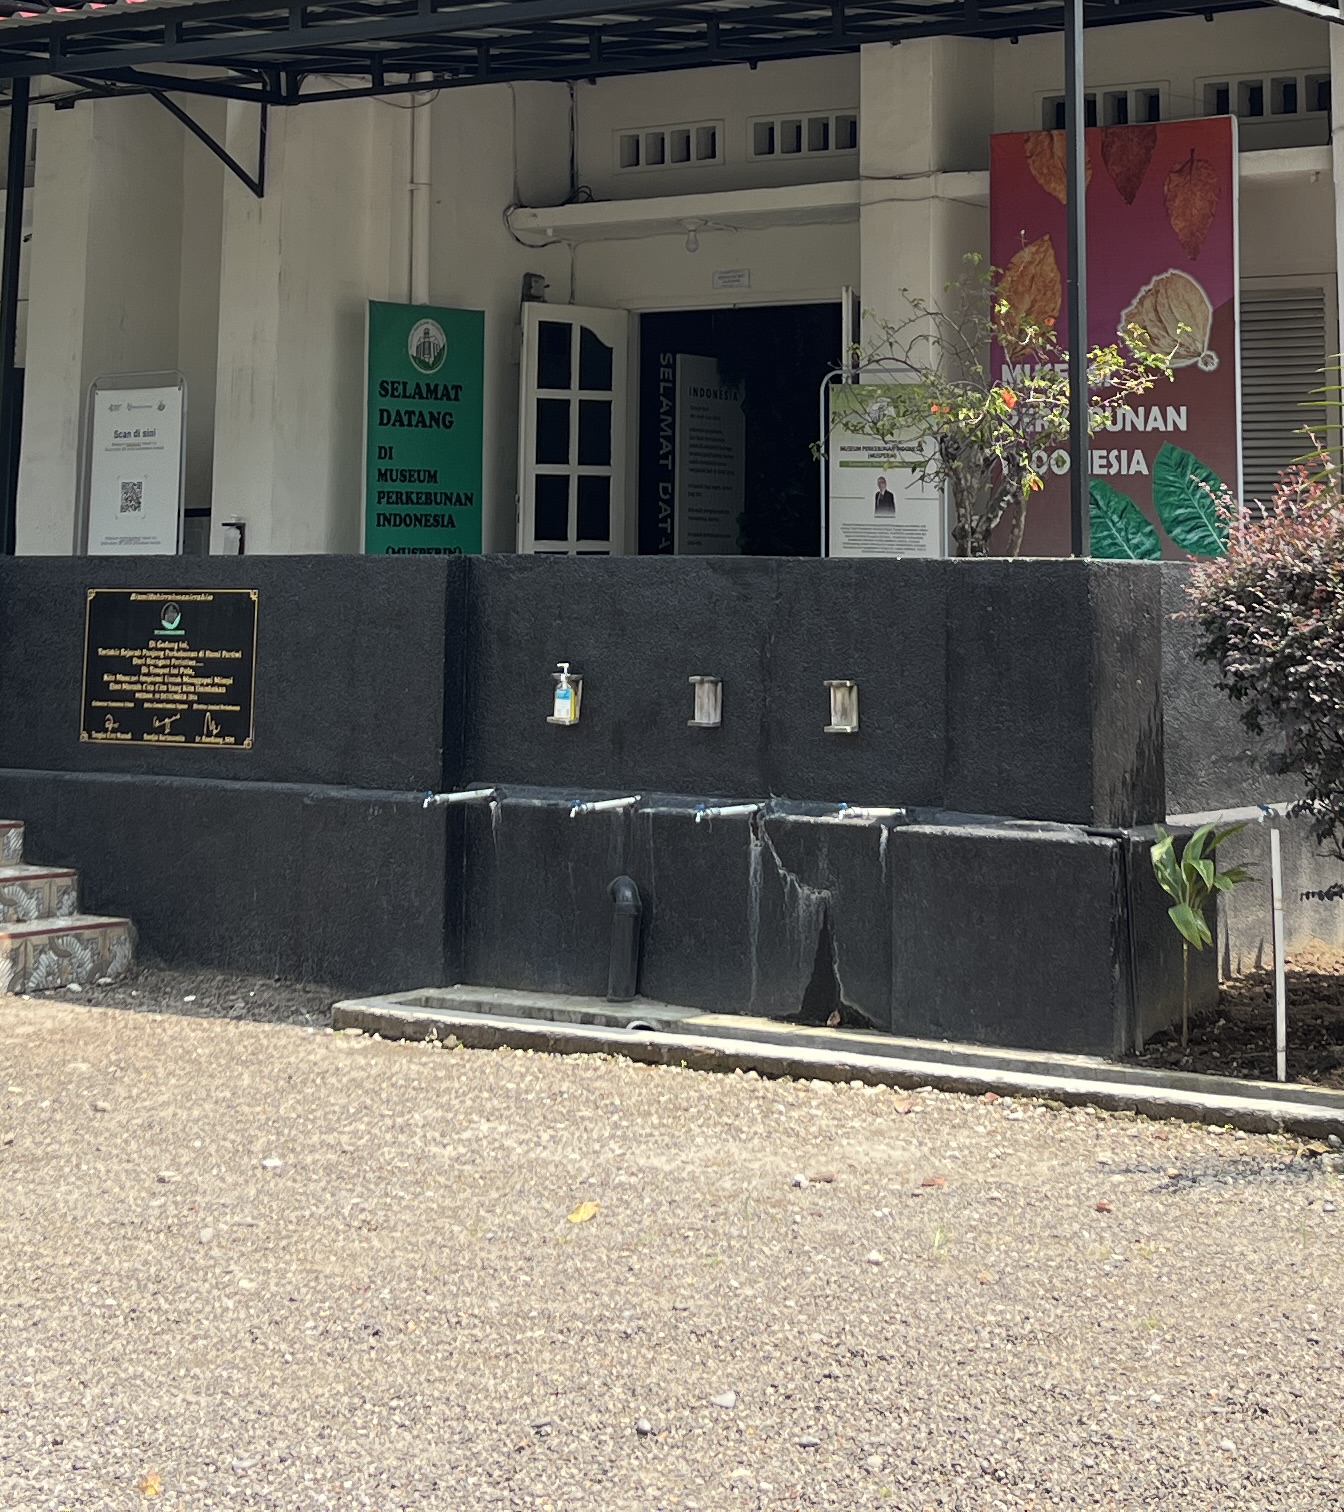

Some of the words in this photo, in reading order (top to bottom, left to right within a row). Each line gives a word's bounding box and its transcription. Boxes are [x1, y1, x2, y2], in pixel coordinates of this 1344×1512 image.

[378, 380, 462, 402] SELAMAT
[688, 385, 738, 402] INDONESIA
[378, 408, 454, 429] DATANG
[659, 352, 673, 471] SELAMAT
[1004, 405, 1187, 432] PERBUNAN
[114, 429, 131, 439] Scan
[133, 428, 141, 438] di
[142, 428, 156, 438] sini
[377, 445, 393, 461] DI
[377, 468, 438, 485] MUSEUM
[377, 490, 474, 507] PERKEBUNAN
[376, 512, 456, 529] INDONESIA
[658, 482, 672, 549] DATA
